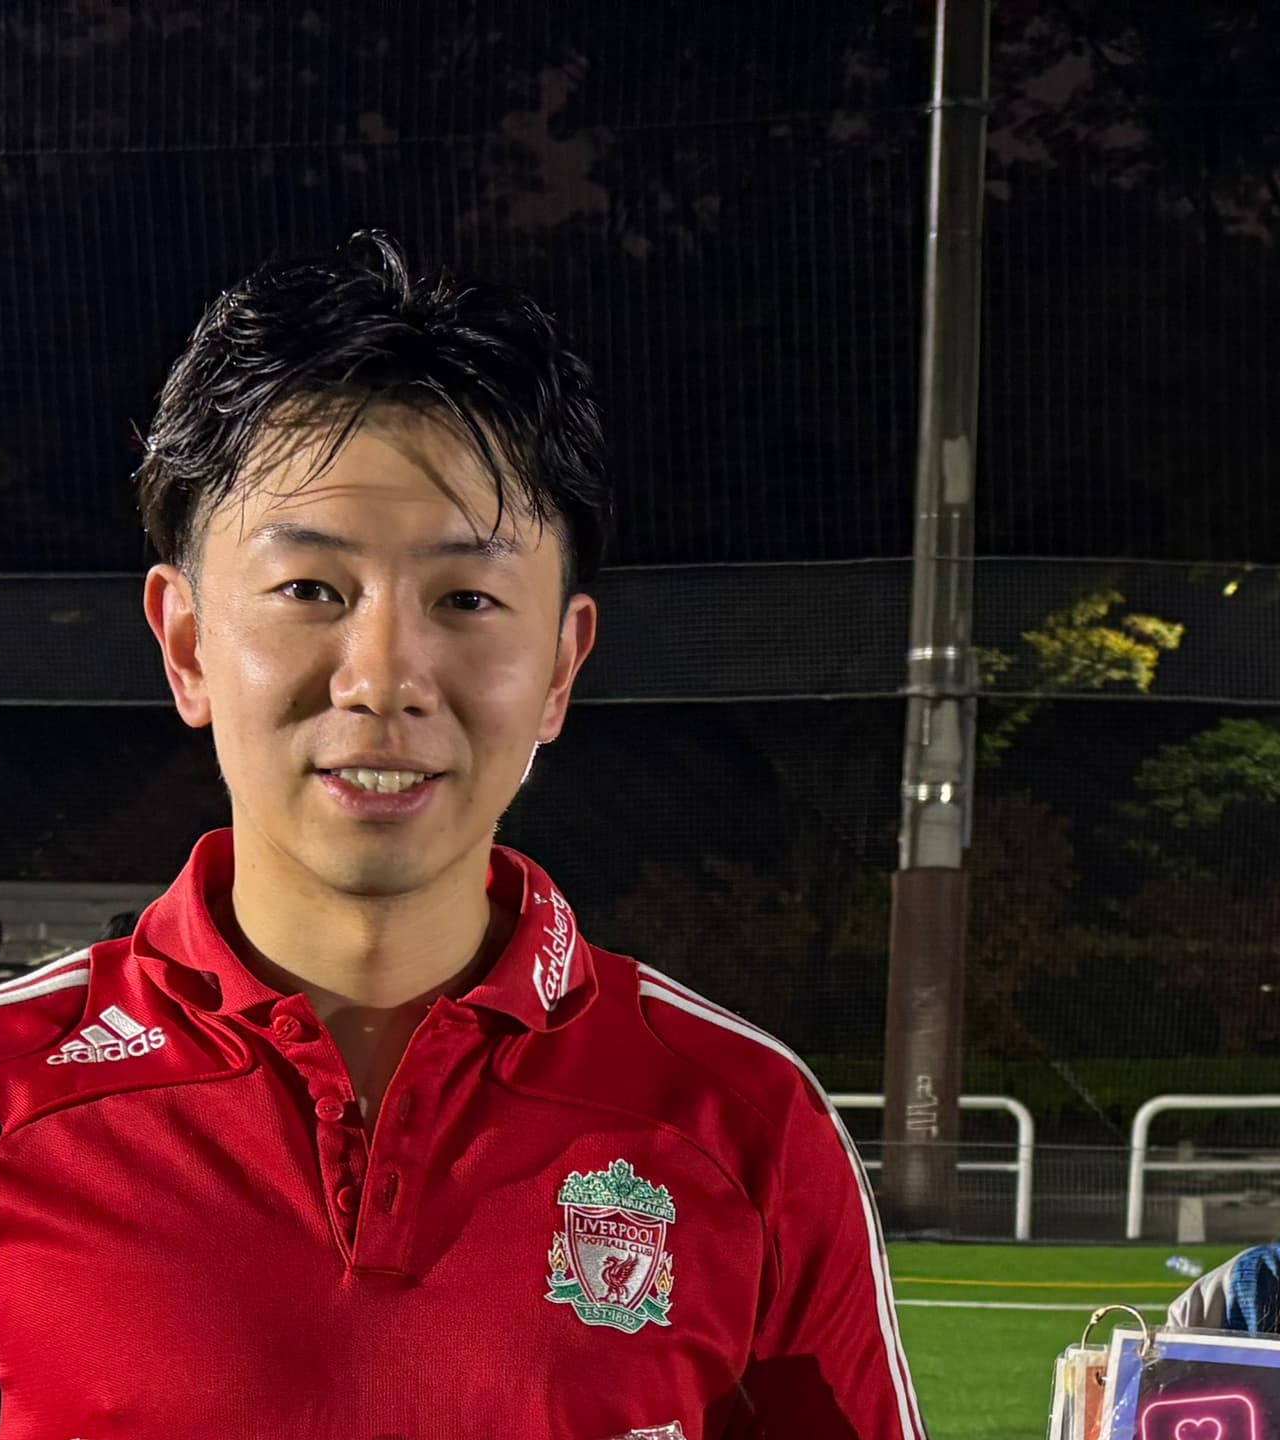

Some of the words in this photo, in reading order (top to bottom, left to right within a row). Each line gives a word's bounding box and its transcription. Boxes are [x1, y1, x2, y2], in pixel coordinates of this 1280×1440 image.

[533, 888, 577, 1011] Carlsberg
[46, 1026, 166, 1065] adidas
[575, 1217, 656, 1246] LIVERPOOL
[628, 1244, 654, 1257] CLUB
